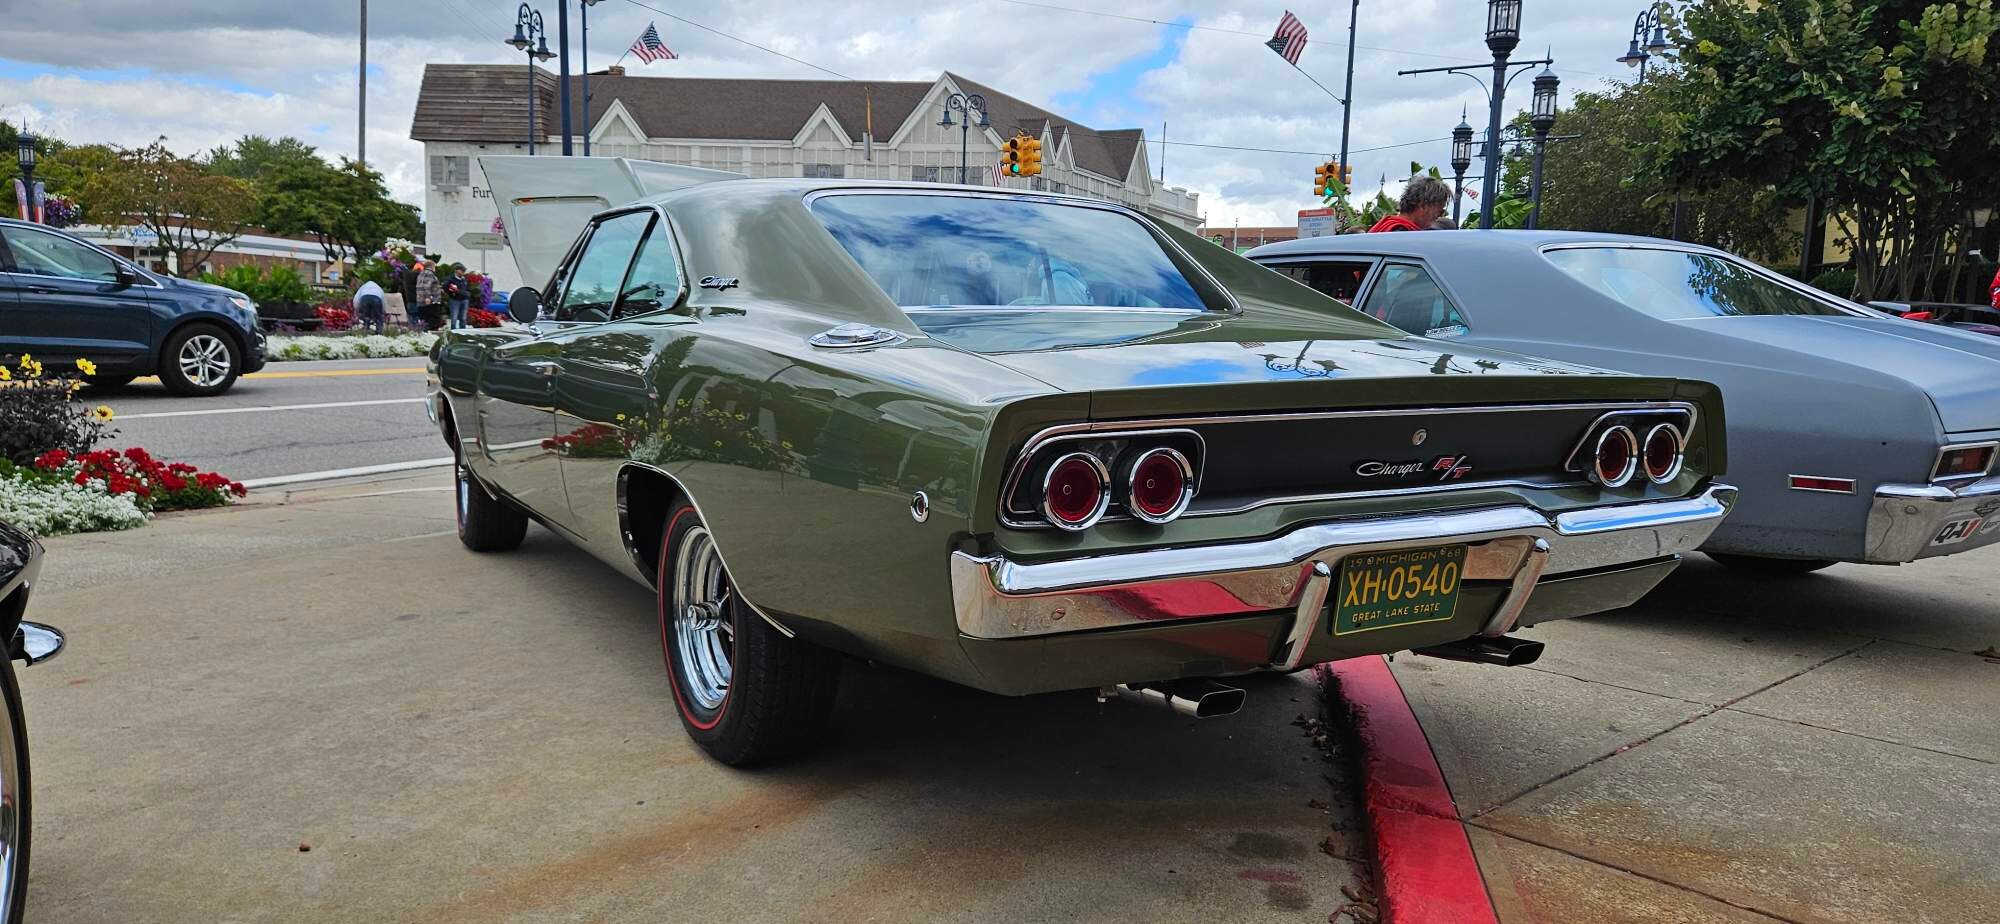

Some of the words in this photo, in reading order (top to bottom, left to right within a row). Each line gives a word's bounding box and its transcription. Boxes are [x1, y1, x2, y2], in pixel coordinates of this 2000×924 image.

[1356, 462, 1424, 478] Charger
[1432, 455, 1473, 480] R/T
[1377, 551, 1438, 566] MICHIGAN
[1447, 548, 1460, 558] 68
[1352, 610, 1381, 623] GREAT
[1386, 606, 1409, 617] LAKE
[1414, 602, 1440, 613] STATE
